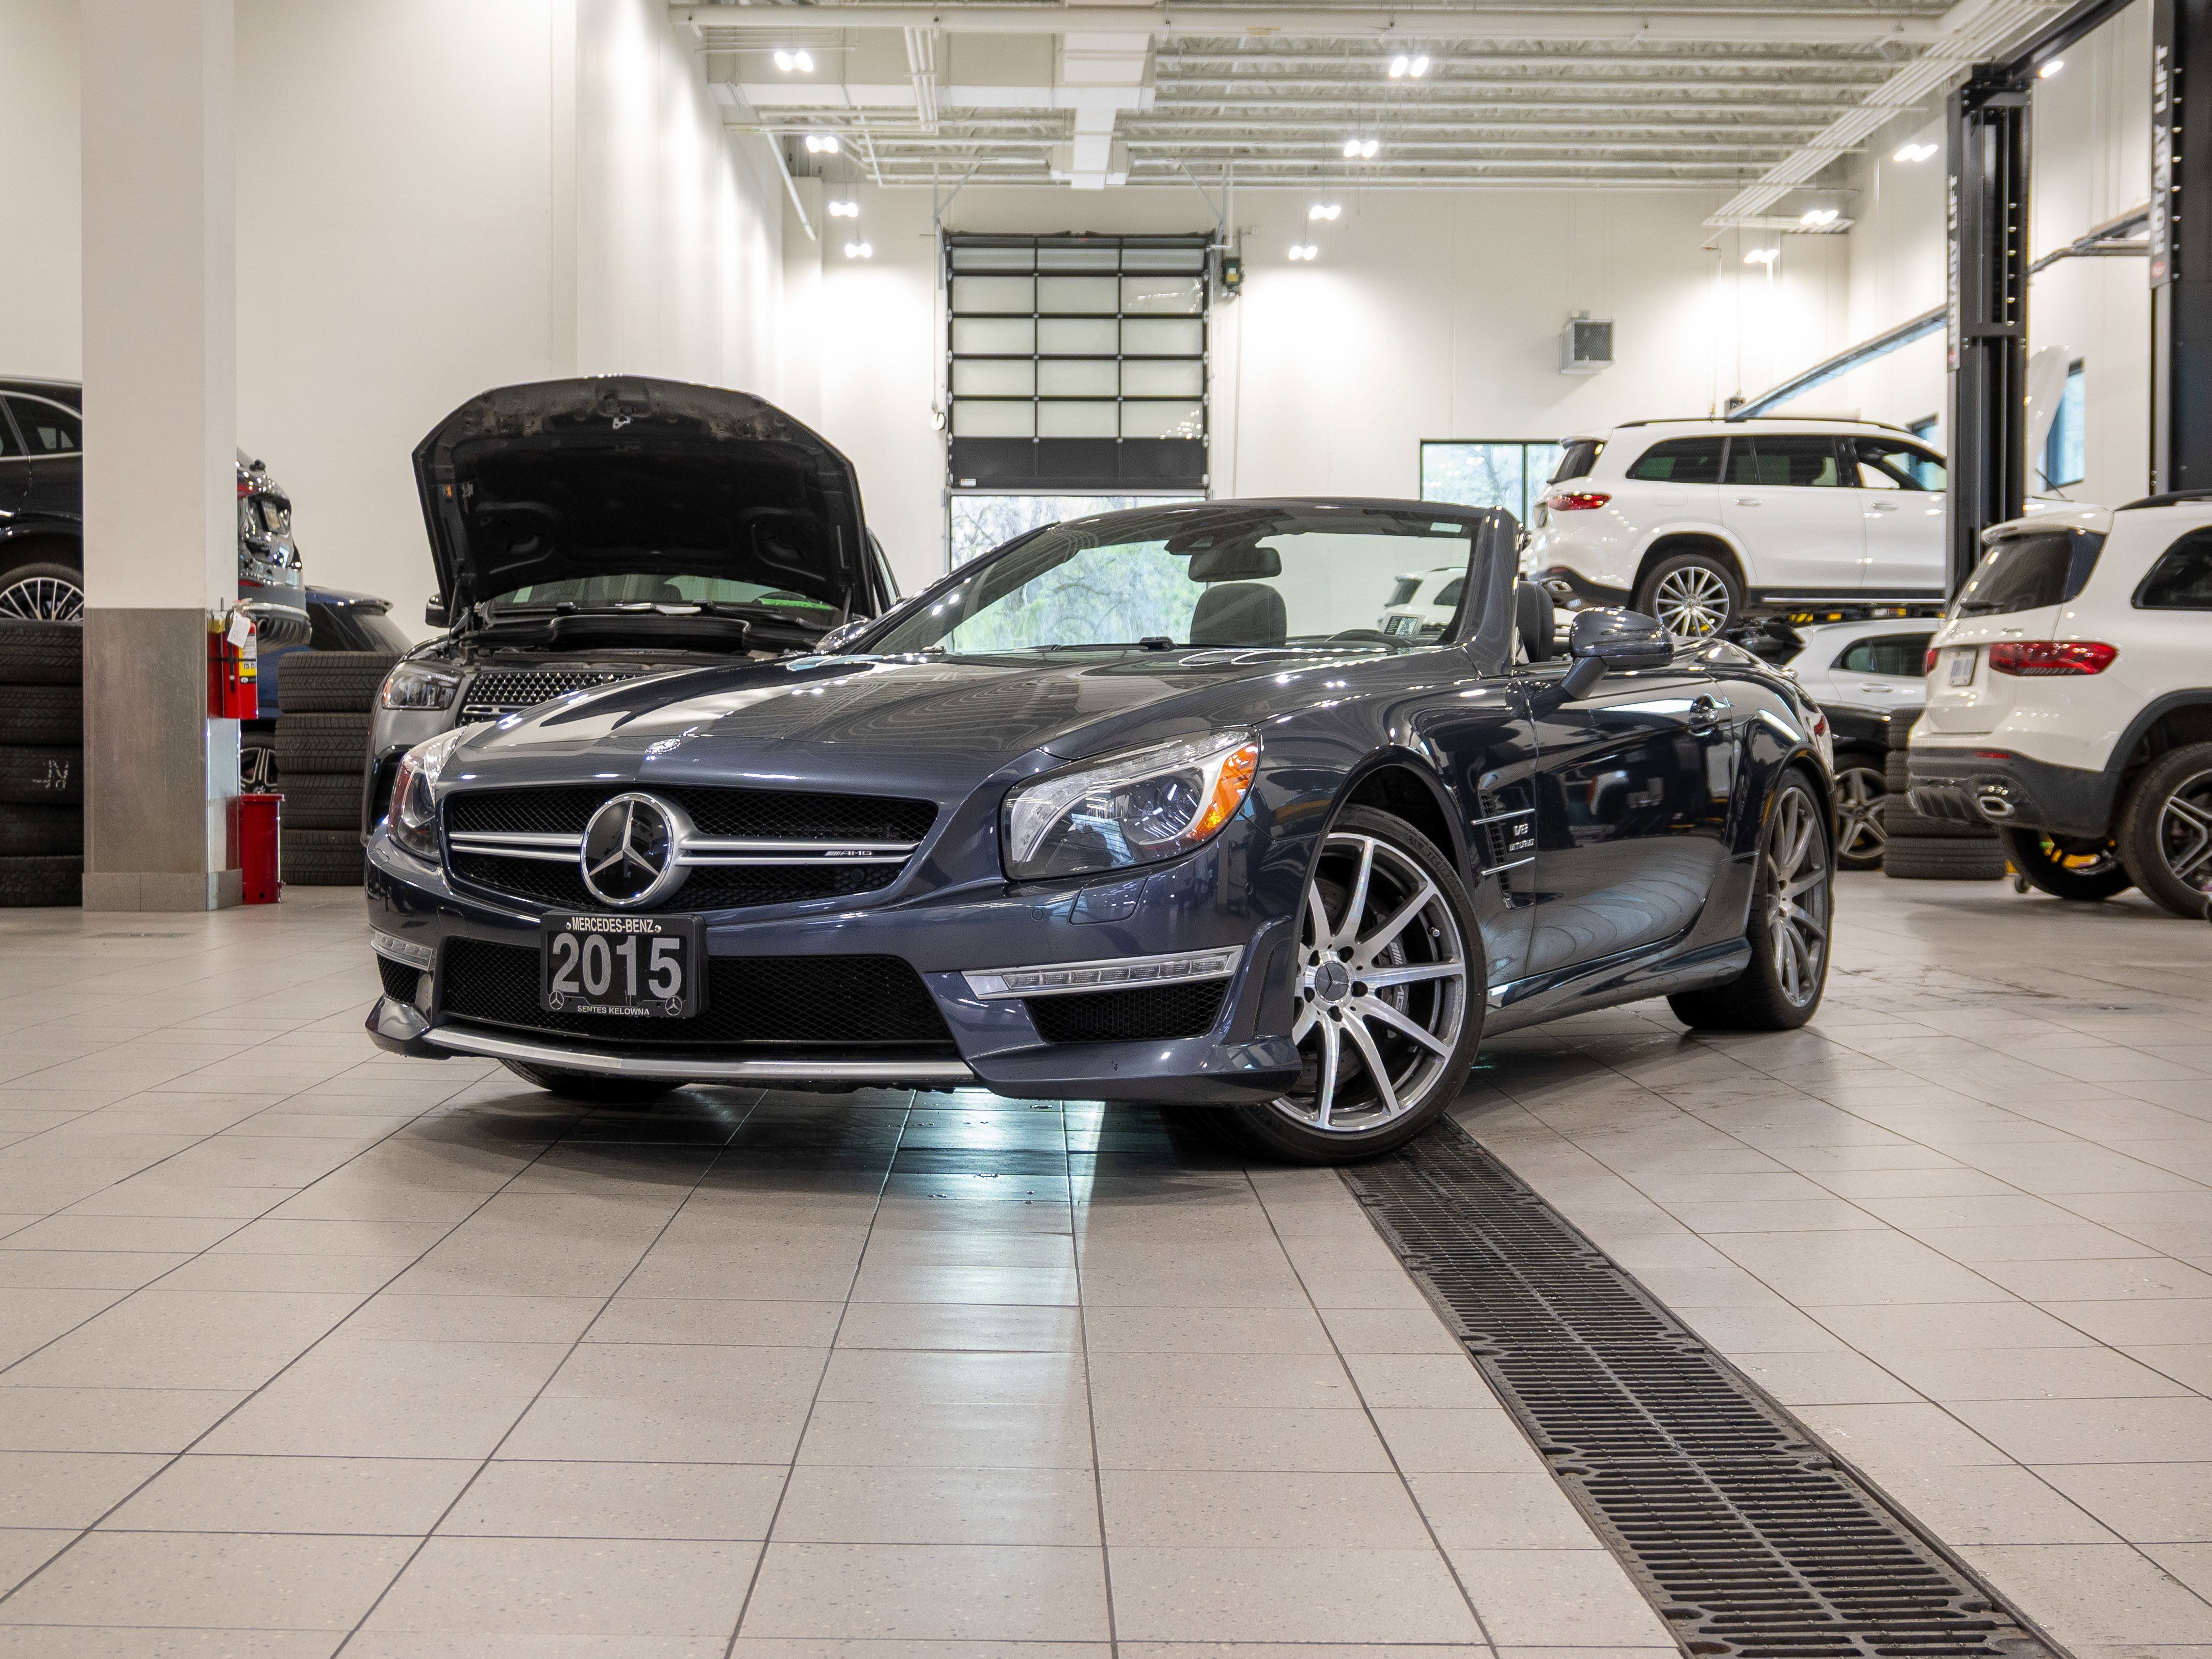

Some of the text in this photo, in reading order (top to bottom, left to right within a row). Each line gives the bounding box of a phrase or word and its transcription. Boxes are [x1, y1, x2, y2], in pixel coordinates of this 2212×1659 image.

[2153, 44, 2168, 255] ROTARY LIFT
[1948, 174, 1958, 344] ROTARY LIFT
[1513, 823, 1528, 836] V8
[1509, 838, 1534, 851] BITURBO
[571, 917, 654, 933] MERCEDES-BENZ
[552, 933, 682, 999] 2015
[577, 1005, 650, 1016] SENTES KELOWNA
